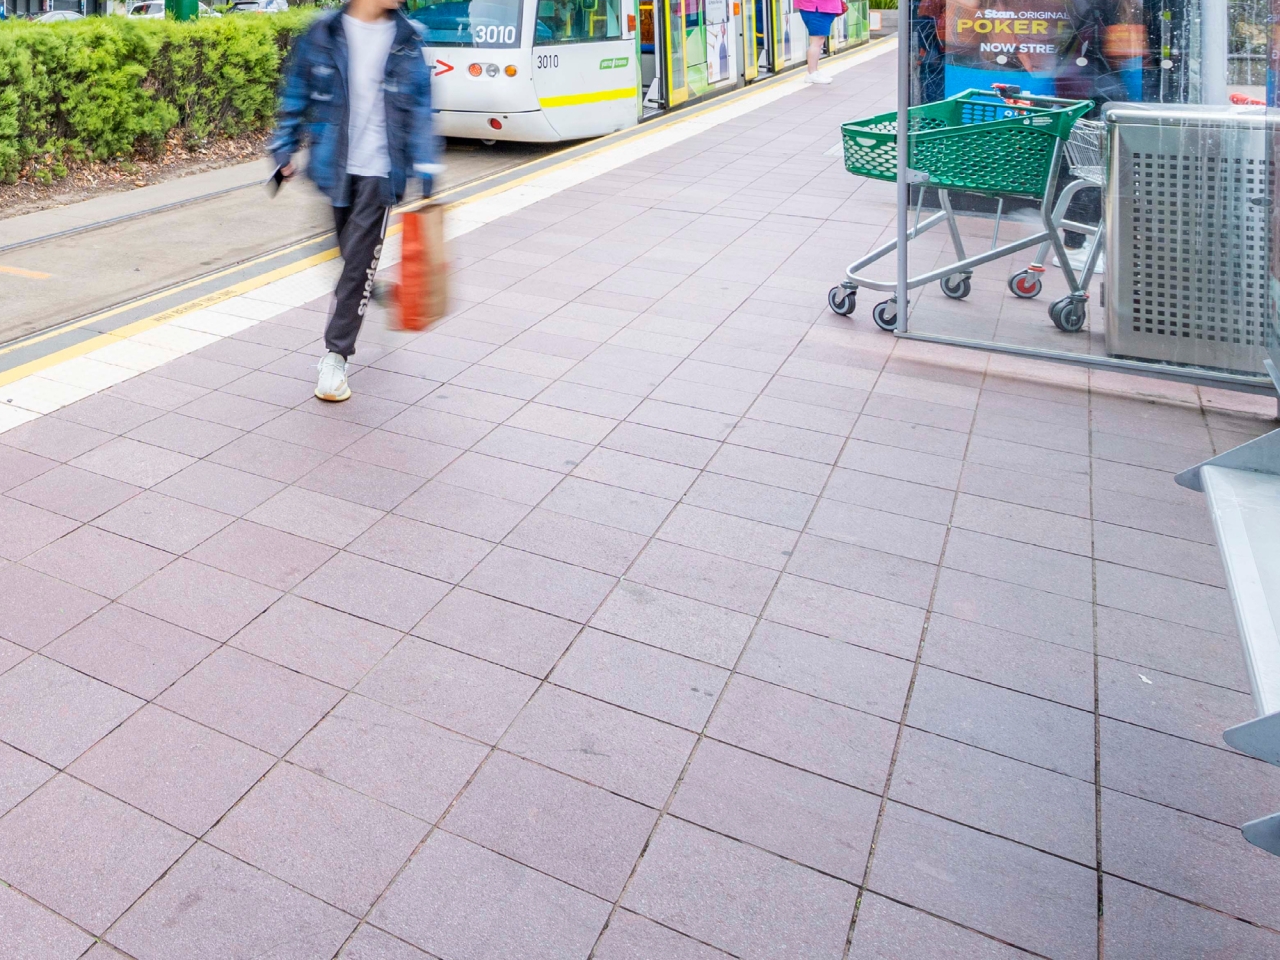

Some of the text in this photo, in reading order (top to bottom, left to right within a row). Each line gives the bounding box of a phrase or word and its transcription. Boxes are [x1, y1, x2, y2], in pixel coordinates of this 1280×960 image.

[1018, 11, 1071, 19] ORIGINAL
[956, 19, 1049, 35] POKER
[475, 25, 516, 44] 3010
[980, 43, 1016, 53] NOW
[537, 55, 559, 69] 3010
